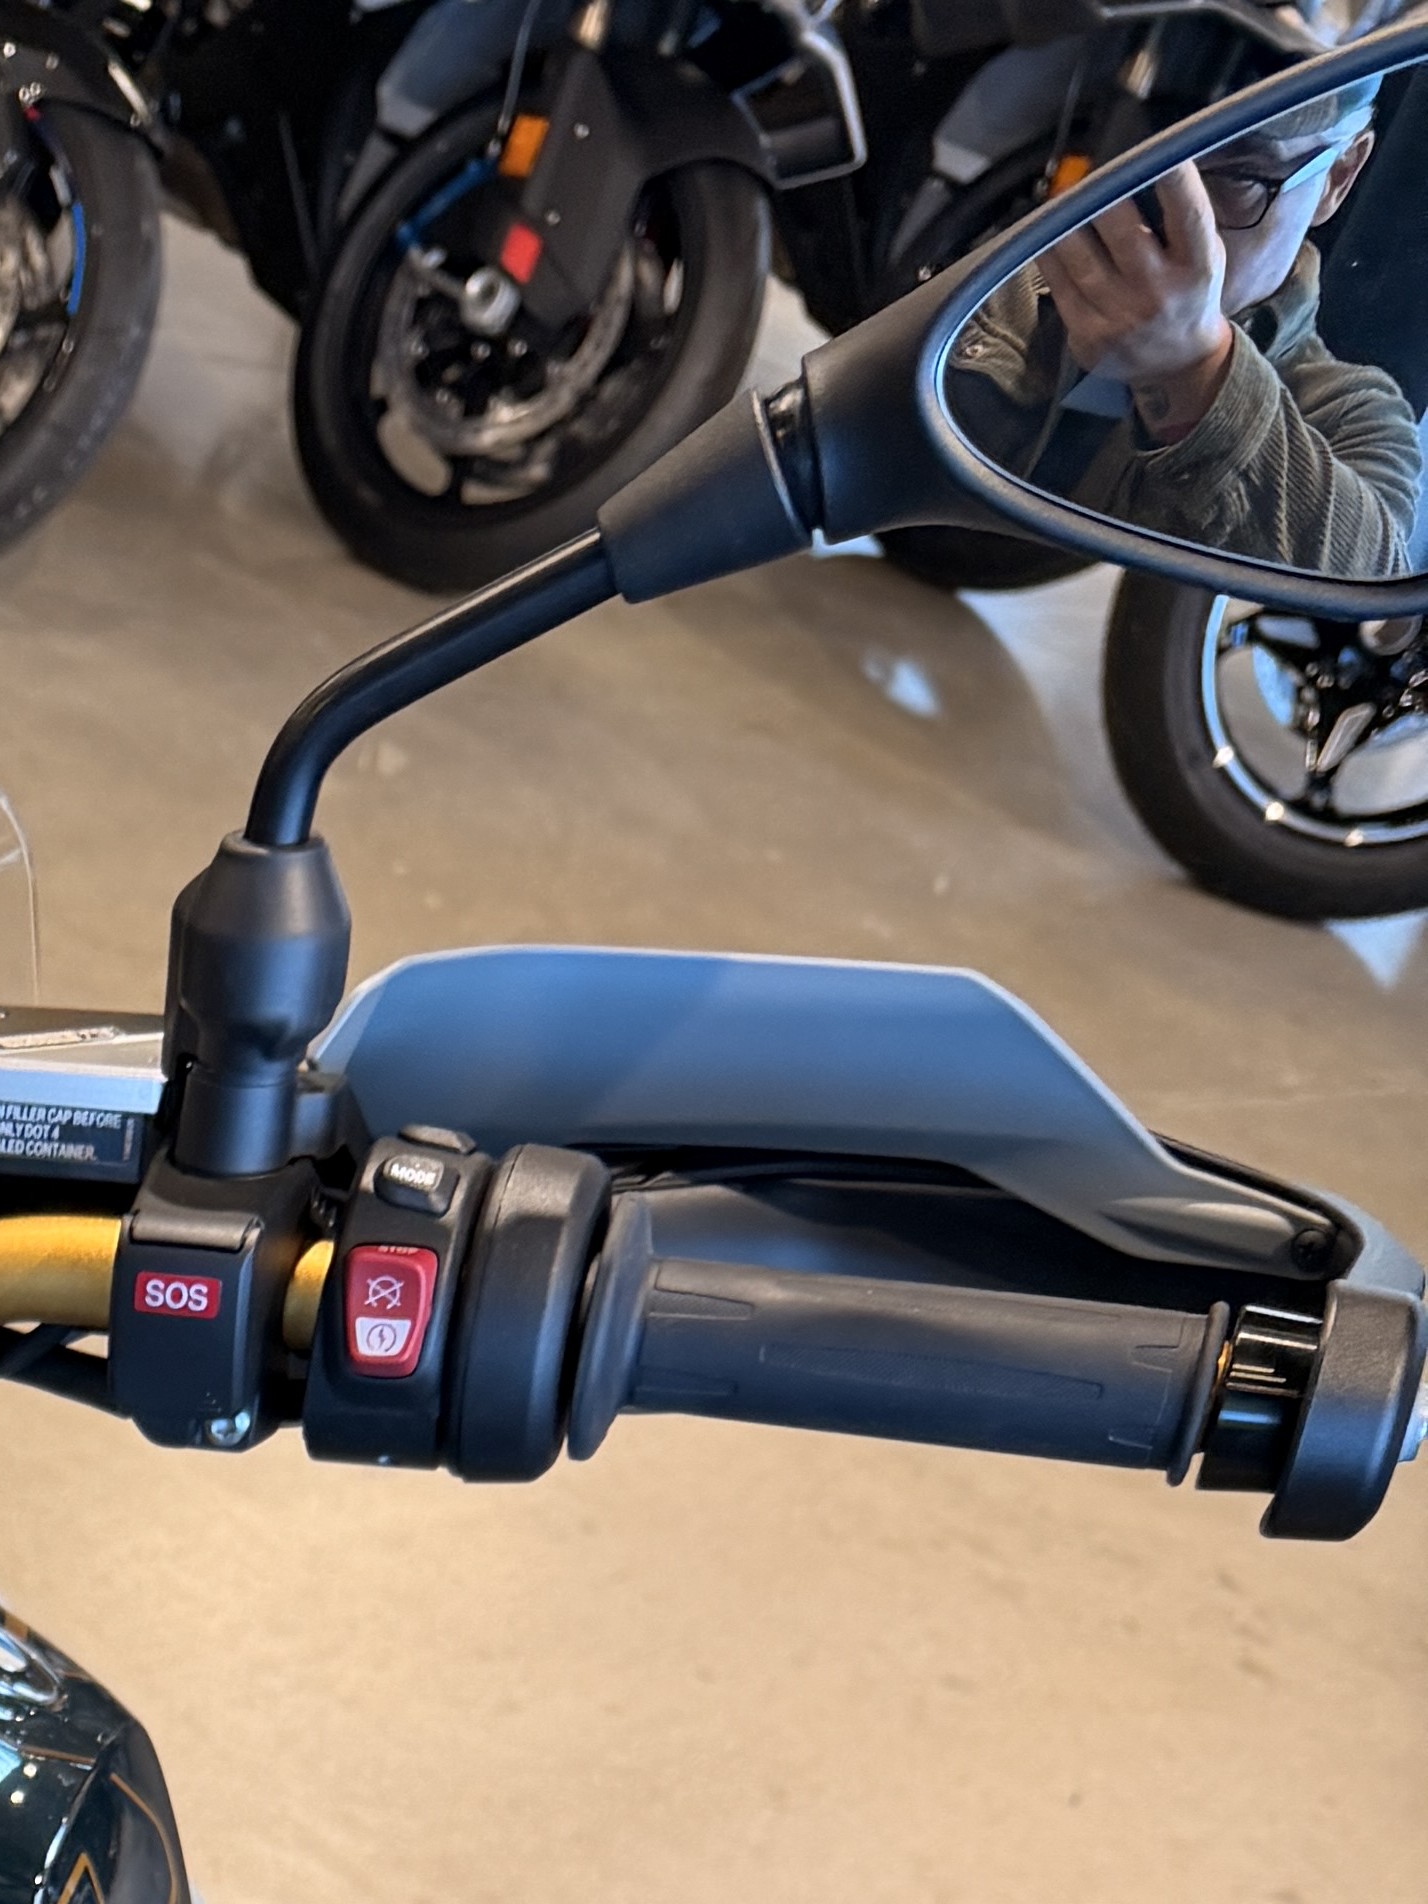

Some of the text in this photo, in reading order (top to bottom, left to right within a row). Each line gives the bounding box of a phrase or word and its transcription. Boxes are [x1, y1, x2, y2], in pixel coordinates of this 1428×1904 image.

[5, 1104, 46, 1122] FILLER
[47, 1108, 72, 1124] CAP
[72, 1110, 122, 1129] BEFORE
[24, 1123, 50, 1140] DOT
[50, 1125, 60, 1140] 4
[390, 1163, 436, 1186] MODE
[145, 1279, 209, 1312] SOS
